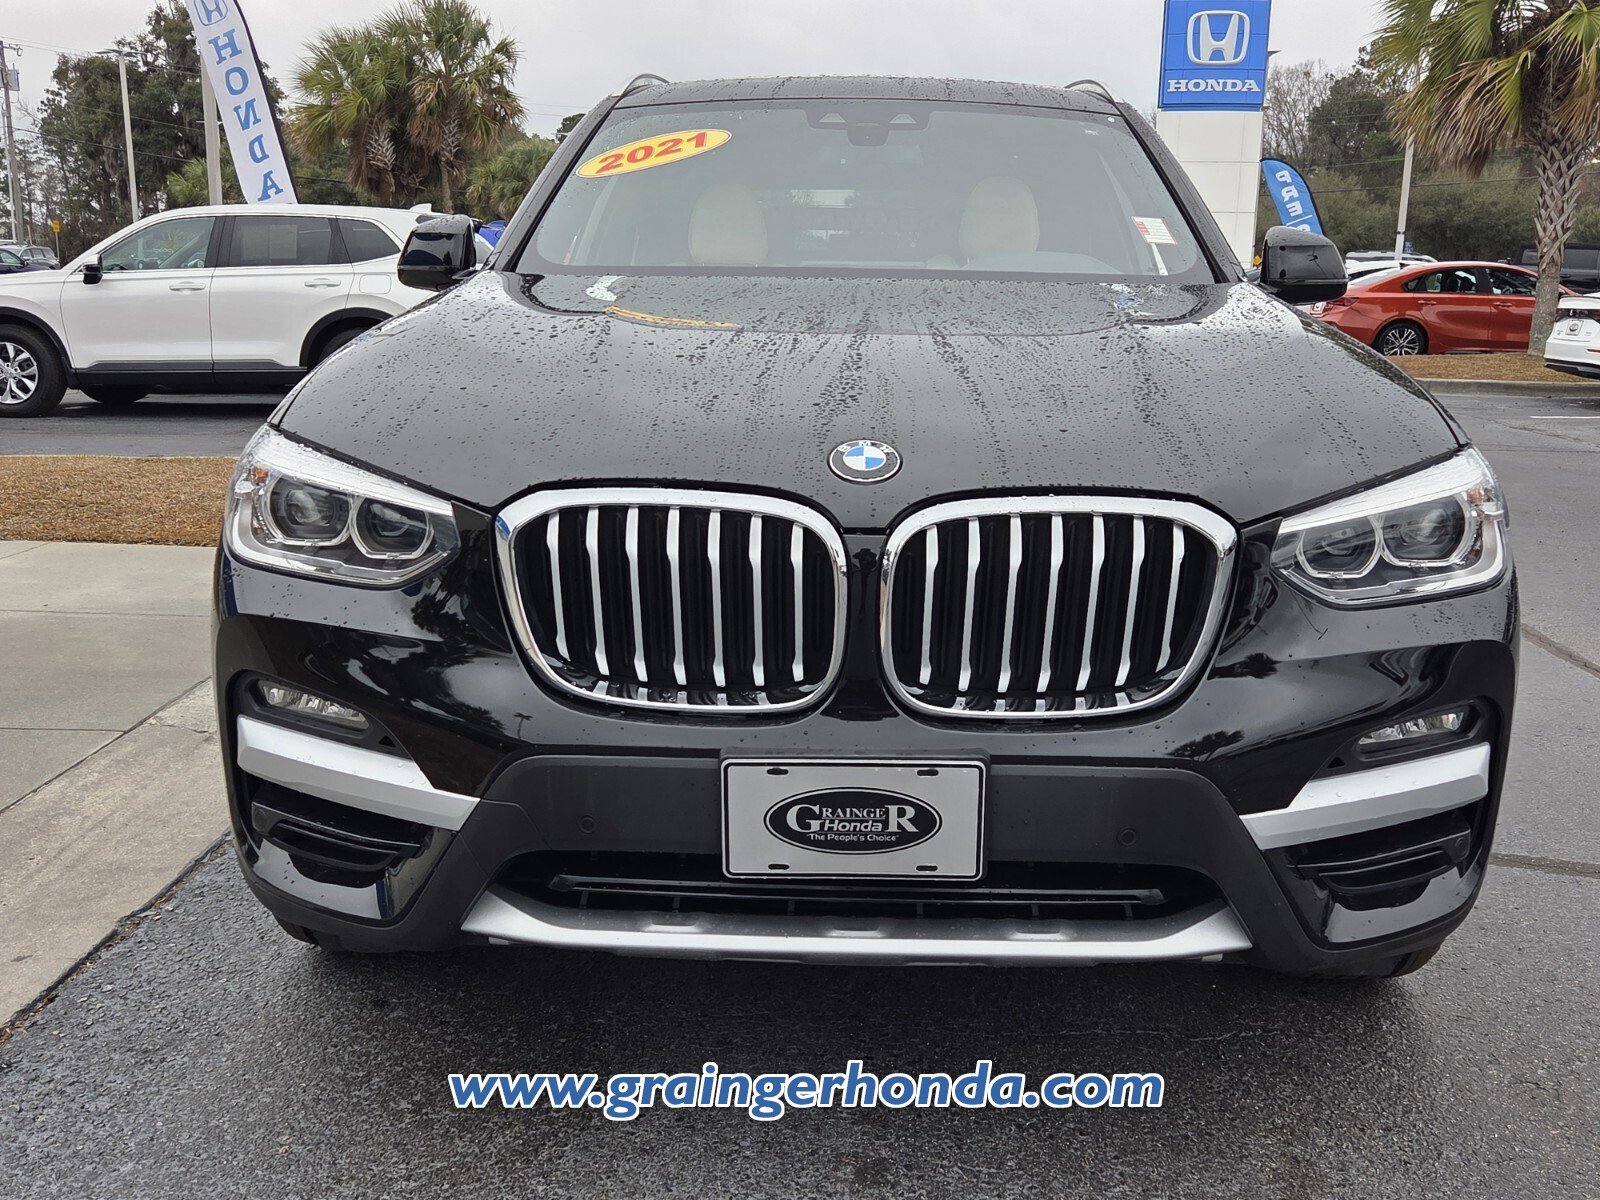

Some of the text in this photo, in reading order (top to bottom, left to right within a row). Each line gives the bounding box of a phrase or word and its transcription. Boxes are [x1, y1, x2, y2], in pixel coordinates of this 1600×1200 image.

[1167, 79, 1261, 92] HONDA
[595, 131, 708, 174] 2021
[837, 440, 894, 454] BMW
[786, 804, 920, 832] GRAINGER
[823, 819, 883, 832] Honda
[827, 833, 865, 842] People's
